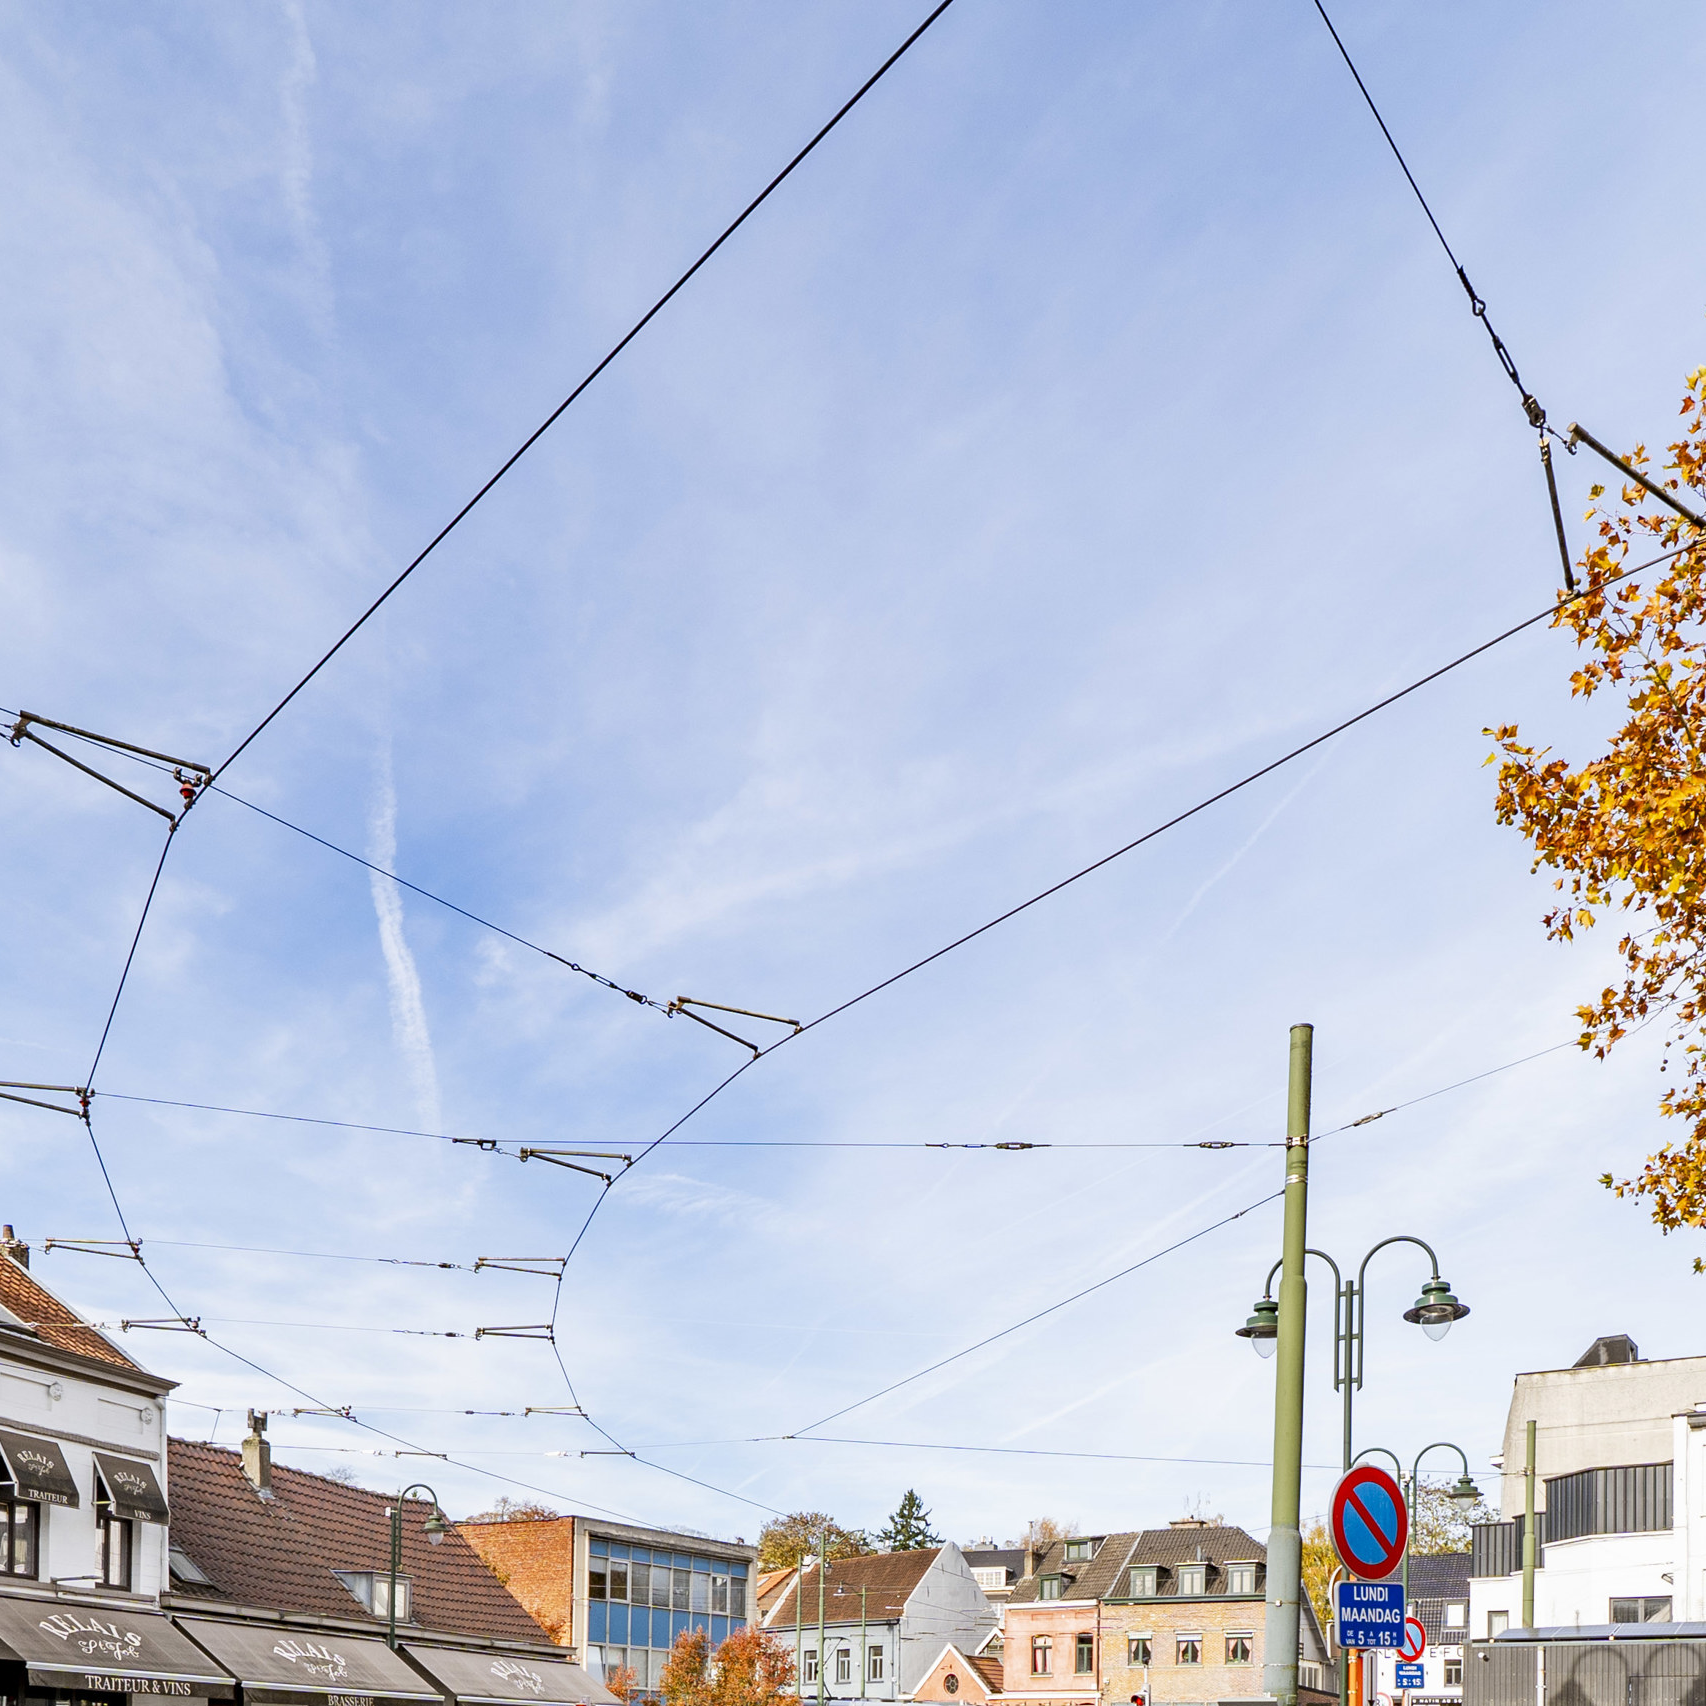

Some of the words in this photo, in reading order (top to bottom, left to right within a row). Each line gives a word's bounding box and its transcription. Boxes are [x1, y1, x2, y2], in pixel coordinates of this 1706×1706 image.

[16, 1450, 55, 1469] RELAIS
[113, 1471, 148, 1489] RELAIS
[28, 1489, 68, 1503] TRAITEUR
[134, 1509, 151, 1520] VINS
[1353, 1586, 1389, 1602] LUNDI
[1341, 1607, 1401, 1623] MAANDAG
[39, 1613, 141, 1647] RELAIS
[1357, 1630, 1365, 1645] 5
[1378, 1631, 1391, 1646] 15
[273, 1640, 346, 1666] RELAIS
[85, 1674, 150, 1693] TRAITEUR
[152, 1681, 161, 1694] &
[163, 1681, 192, 1696] VINS
